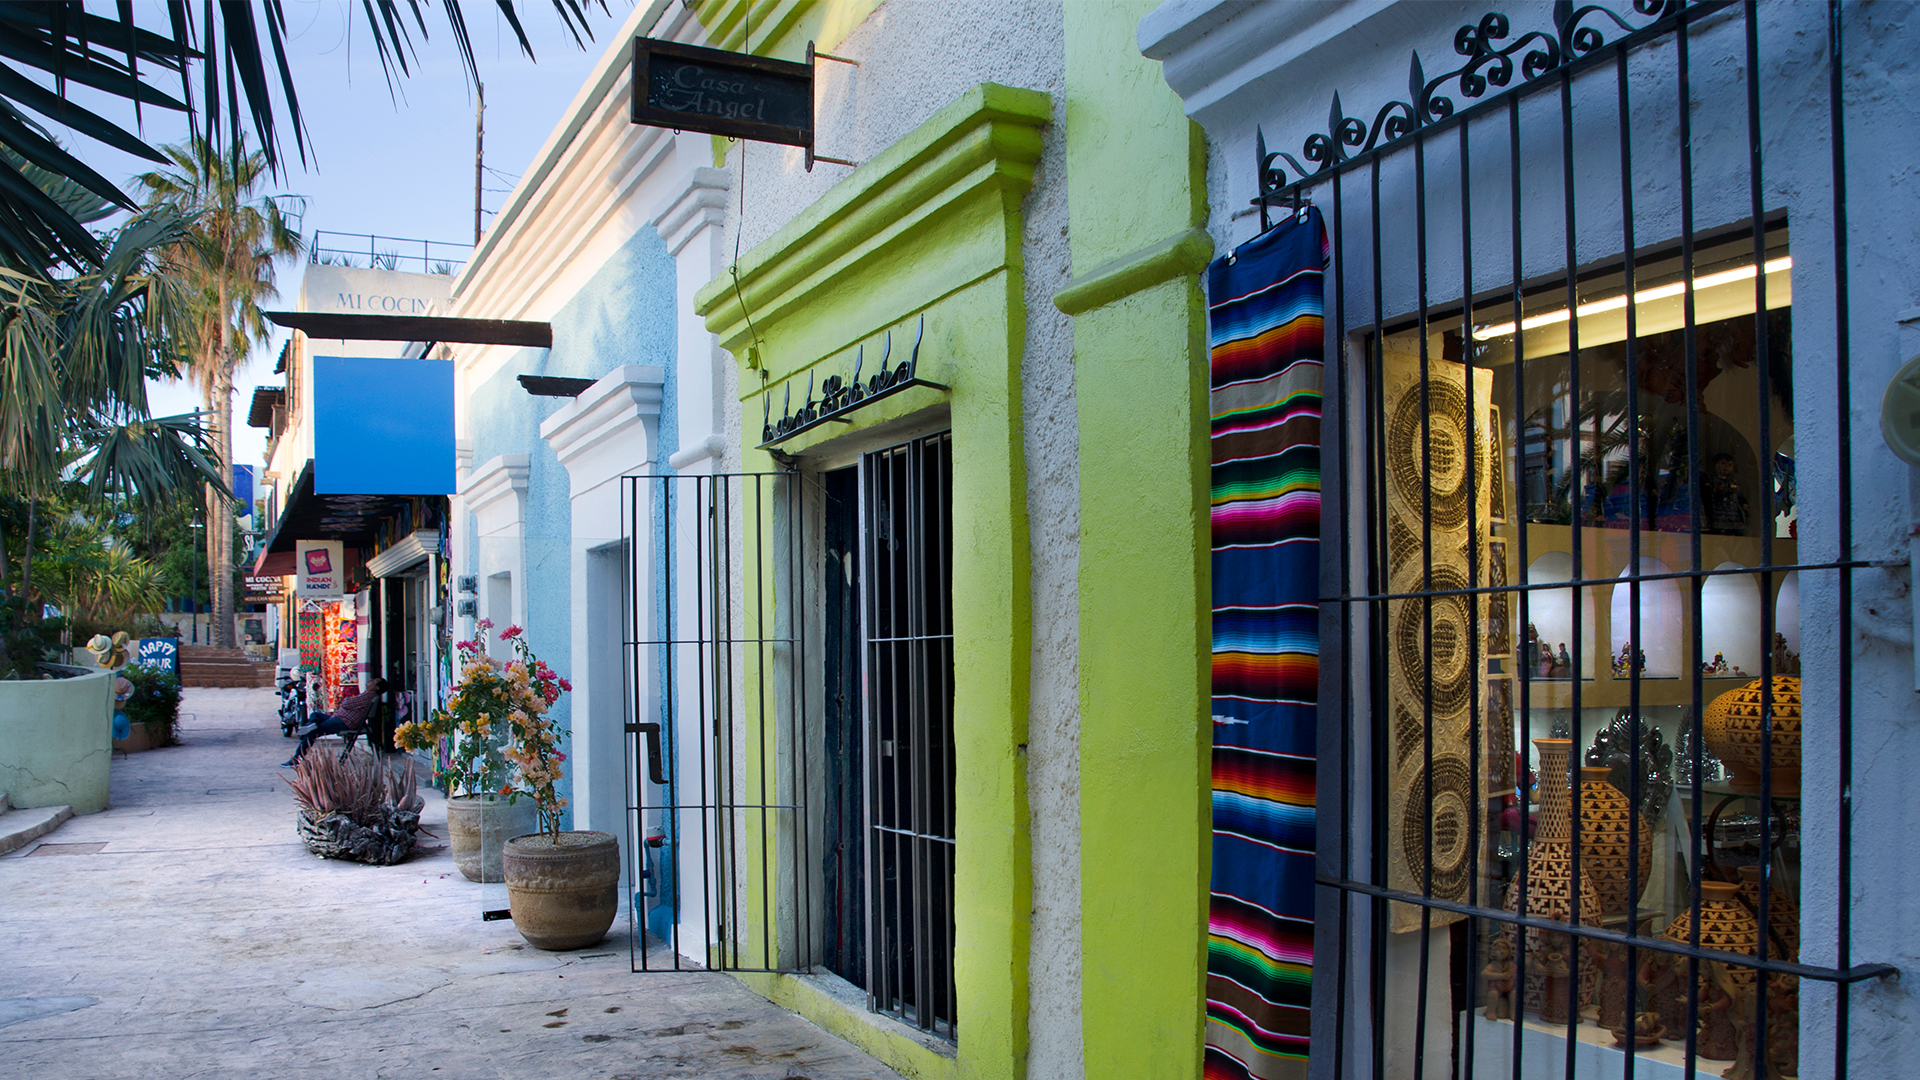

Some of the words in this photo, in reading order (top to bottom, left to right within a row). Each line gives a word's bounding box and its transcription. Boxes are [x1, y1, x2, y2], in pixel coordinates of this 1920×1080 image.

[674, 65, 745, 94] Casa
[659, 88, 765, 120] Angel
[336, 293, 361, 309] MI
[138, 641, 176, 657] HAPPY
